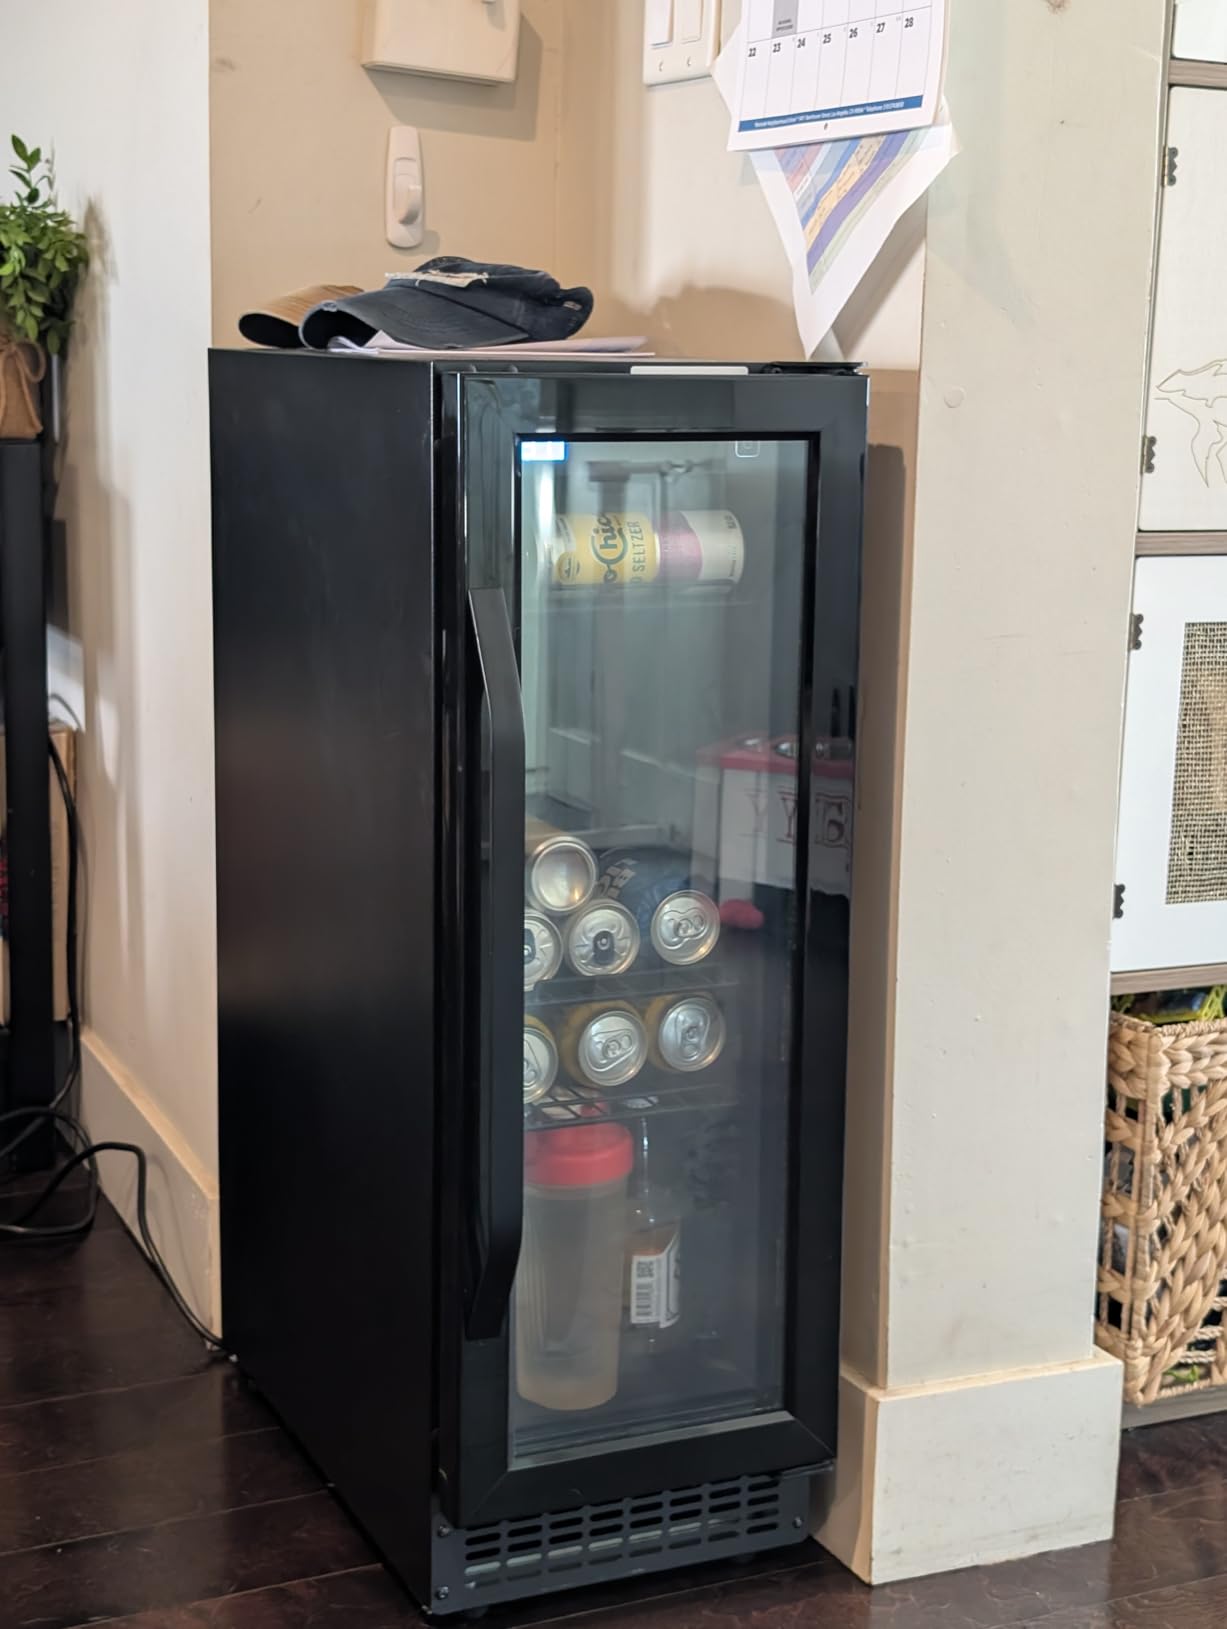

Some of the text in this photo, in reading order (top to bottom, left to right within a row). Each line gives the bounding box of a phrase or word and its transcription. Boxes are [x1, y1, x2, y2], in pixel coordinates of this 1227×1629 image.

[748, 47, 756, 57] 22
[773, 42, 781, 53] 23
[797, 37, 806, 48] 24
[823, 34, 831, 44] 25
[849, 27, 858, 38] 26
[876, 22, 885, 33] 27
[904, 17, 913, 28] 28
[627, 521, 646, 572] SELTZER
